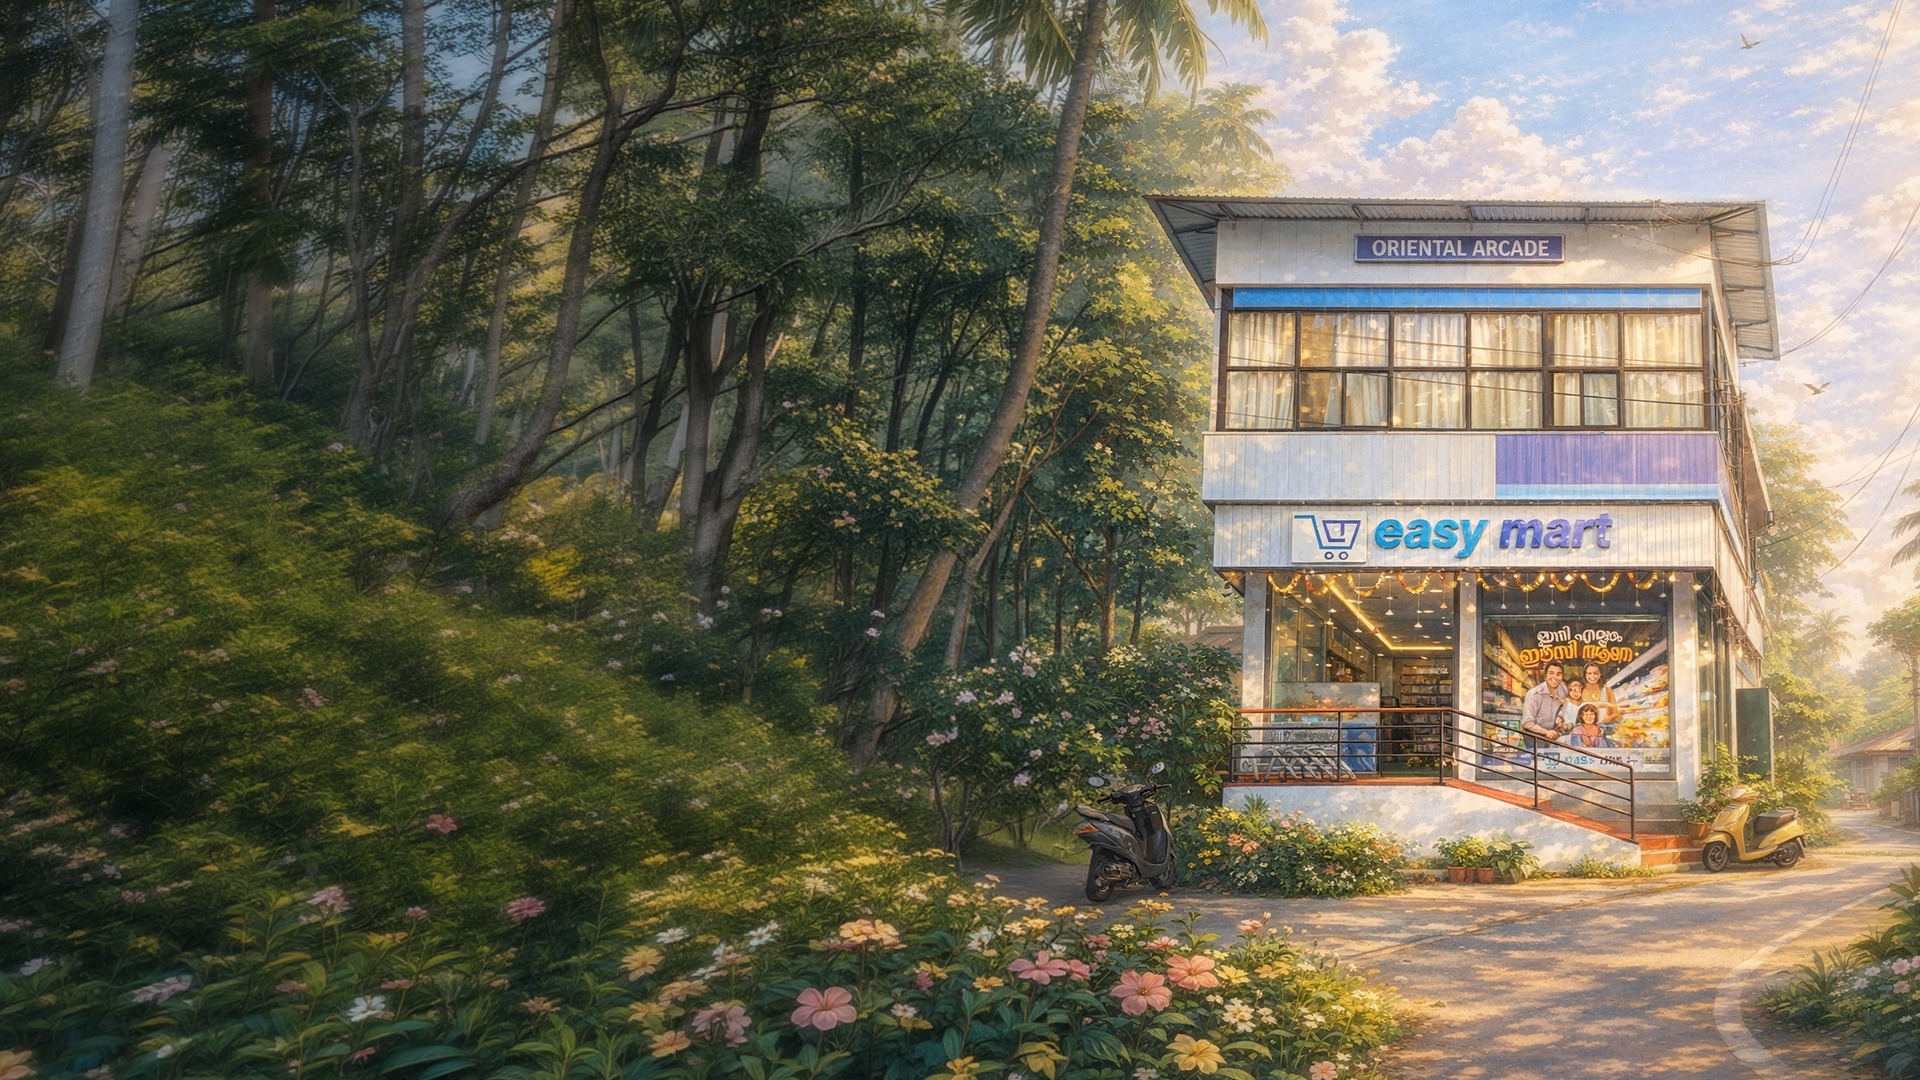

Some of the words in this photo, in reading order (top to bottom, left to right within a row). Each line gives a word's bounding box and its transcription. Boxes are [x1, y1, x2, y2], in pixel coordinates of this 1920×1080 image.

[1371, 239, 1467, 257] ORIENTAL
[1472, 239, 1550, 257] ARCADE
[1374, 518, 1489, 559] easy
[1499, 512, 1614, 549] mart
